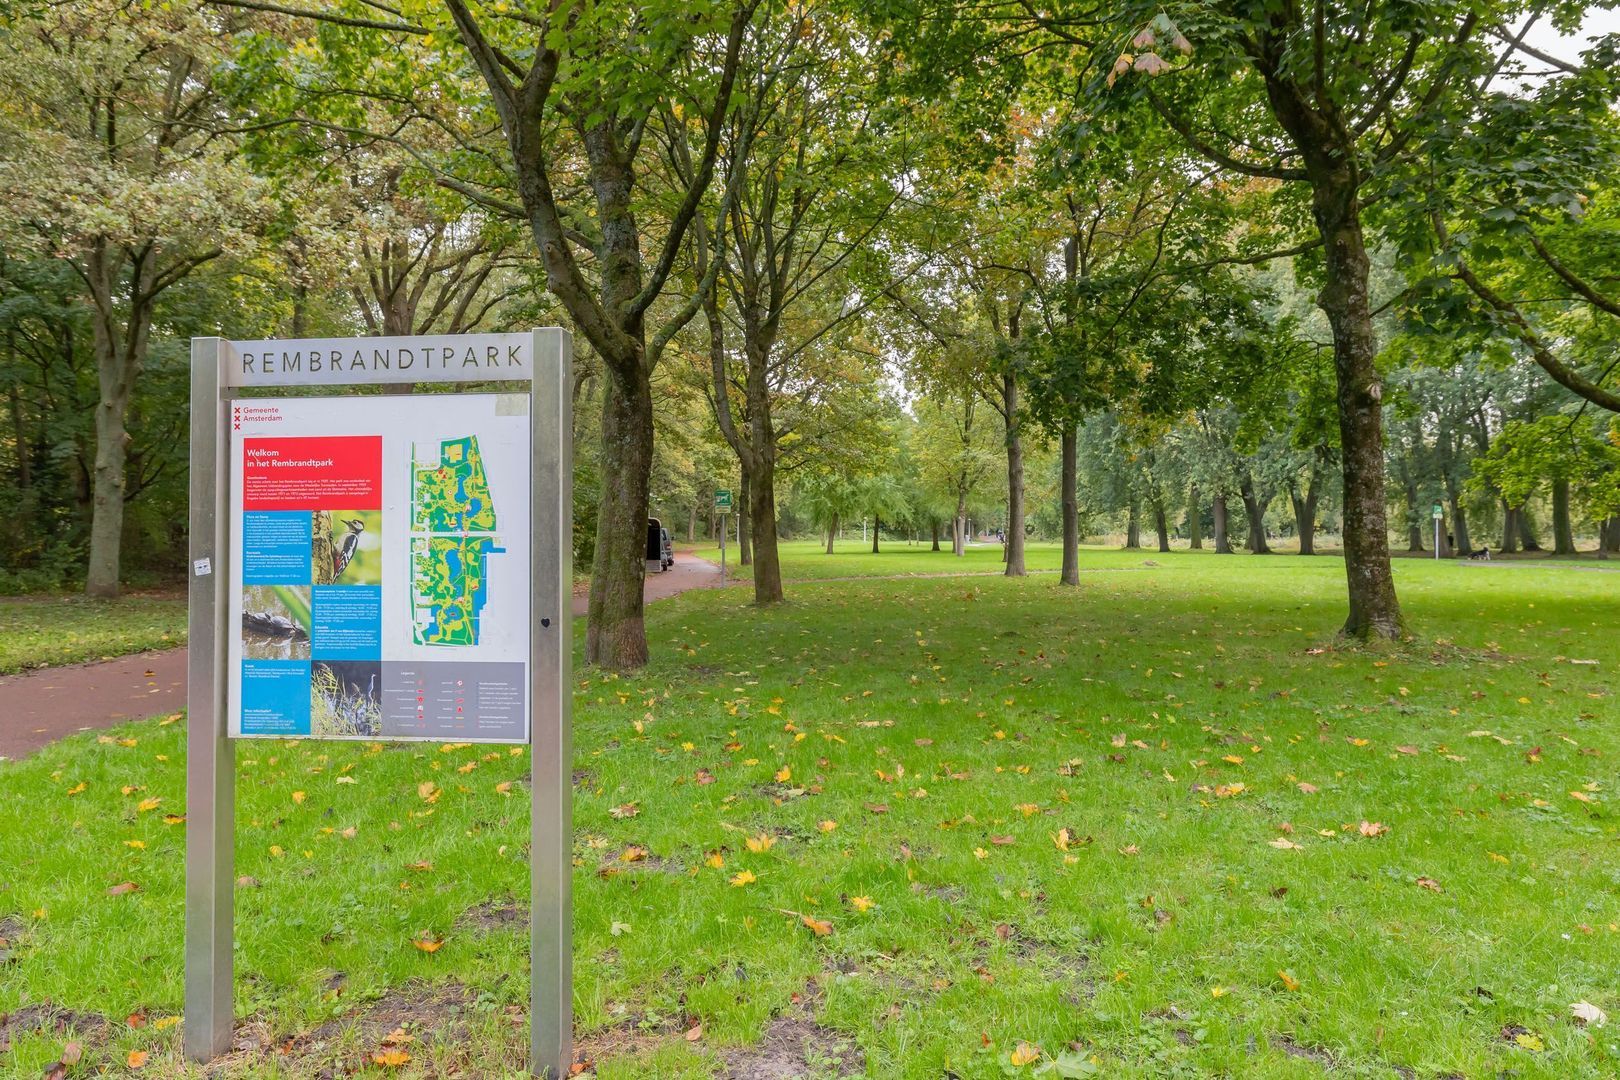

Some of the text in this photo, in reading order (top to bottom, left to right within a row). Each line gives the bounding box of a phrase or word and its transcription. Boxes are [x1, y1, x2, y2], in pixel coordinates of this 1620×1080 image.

[242, 345, 522, 374] REMBRANDTPARK
[247, 449, 279, 457] Welkom
[247, 459, 334, 468] in het Rembrandtpark
